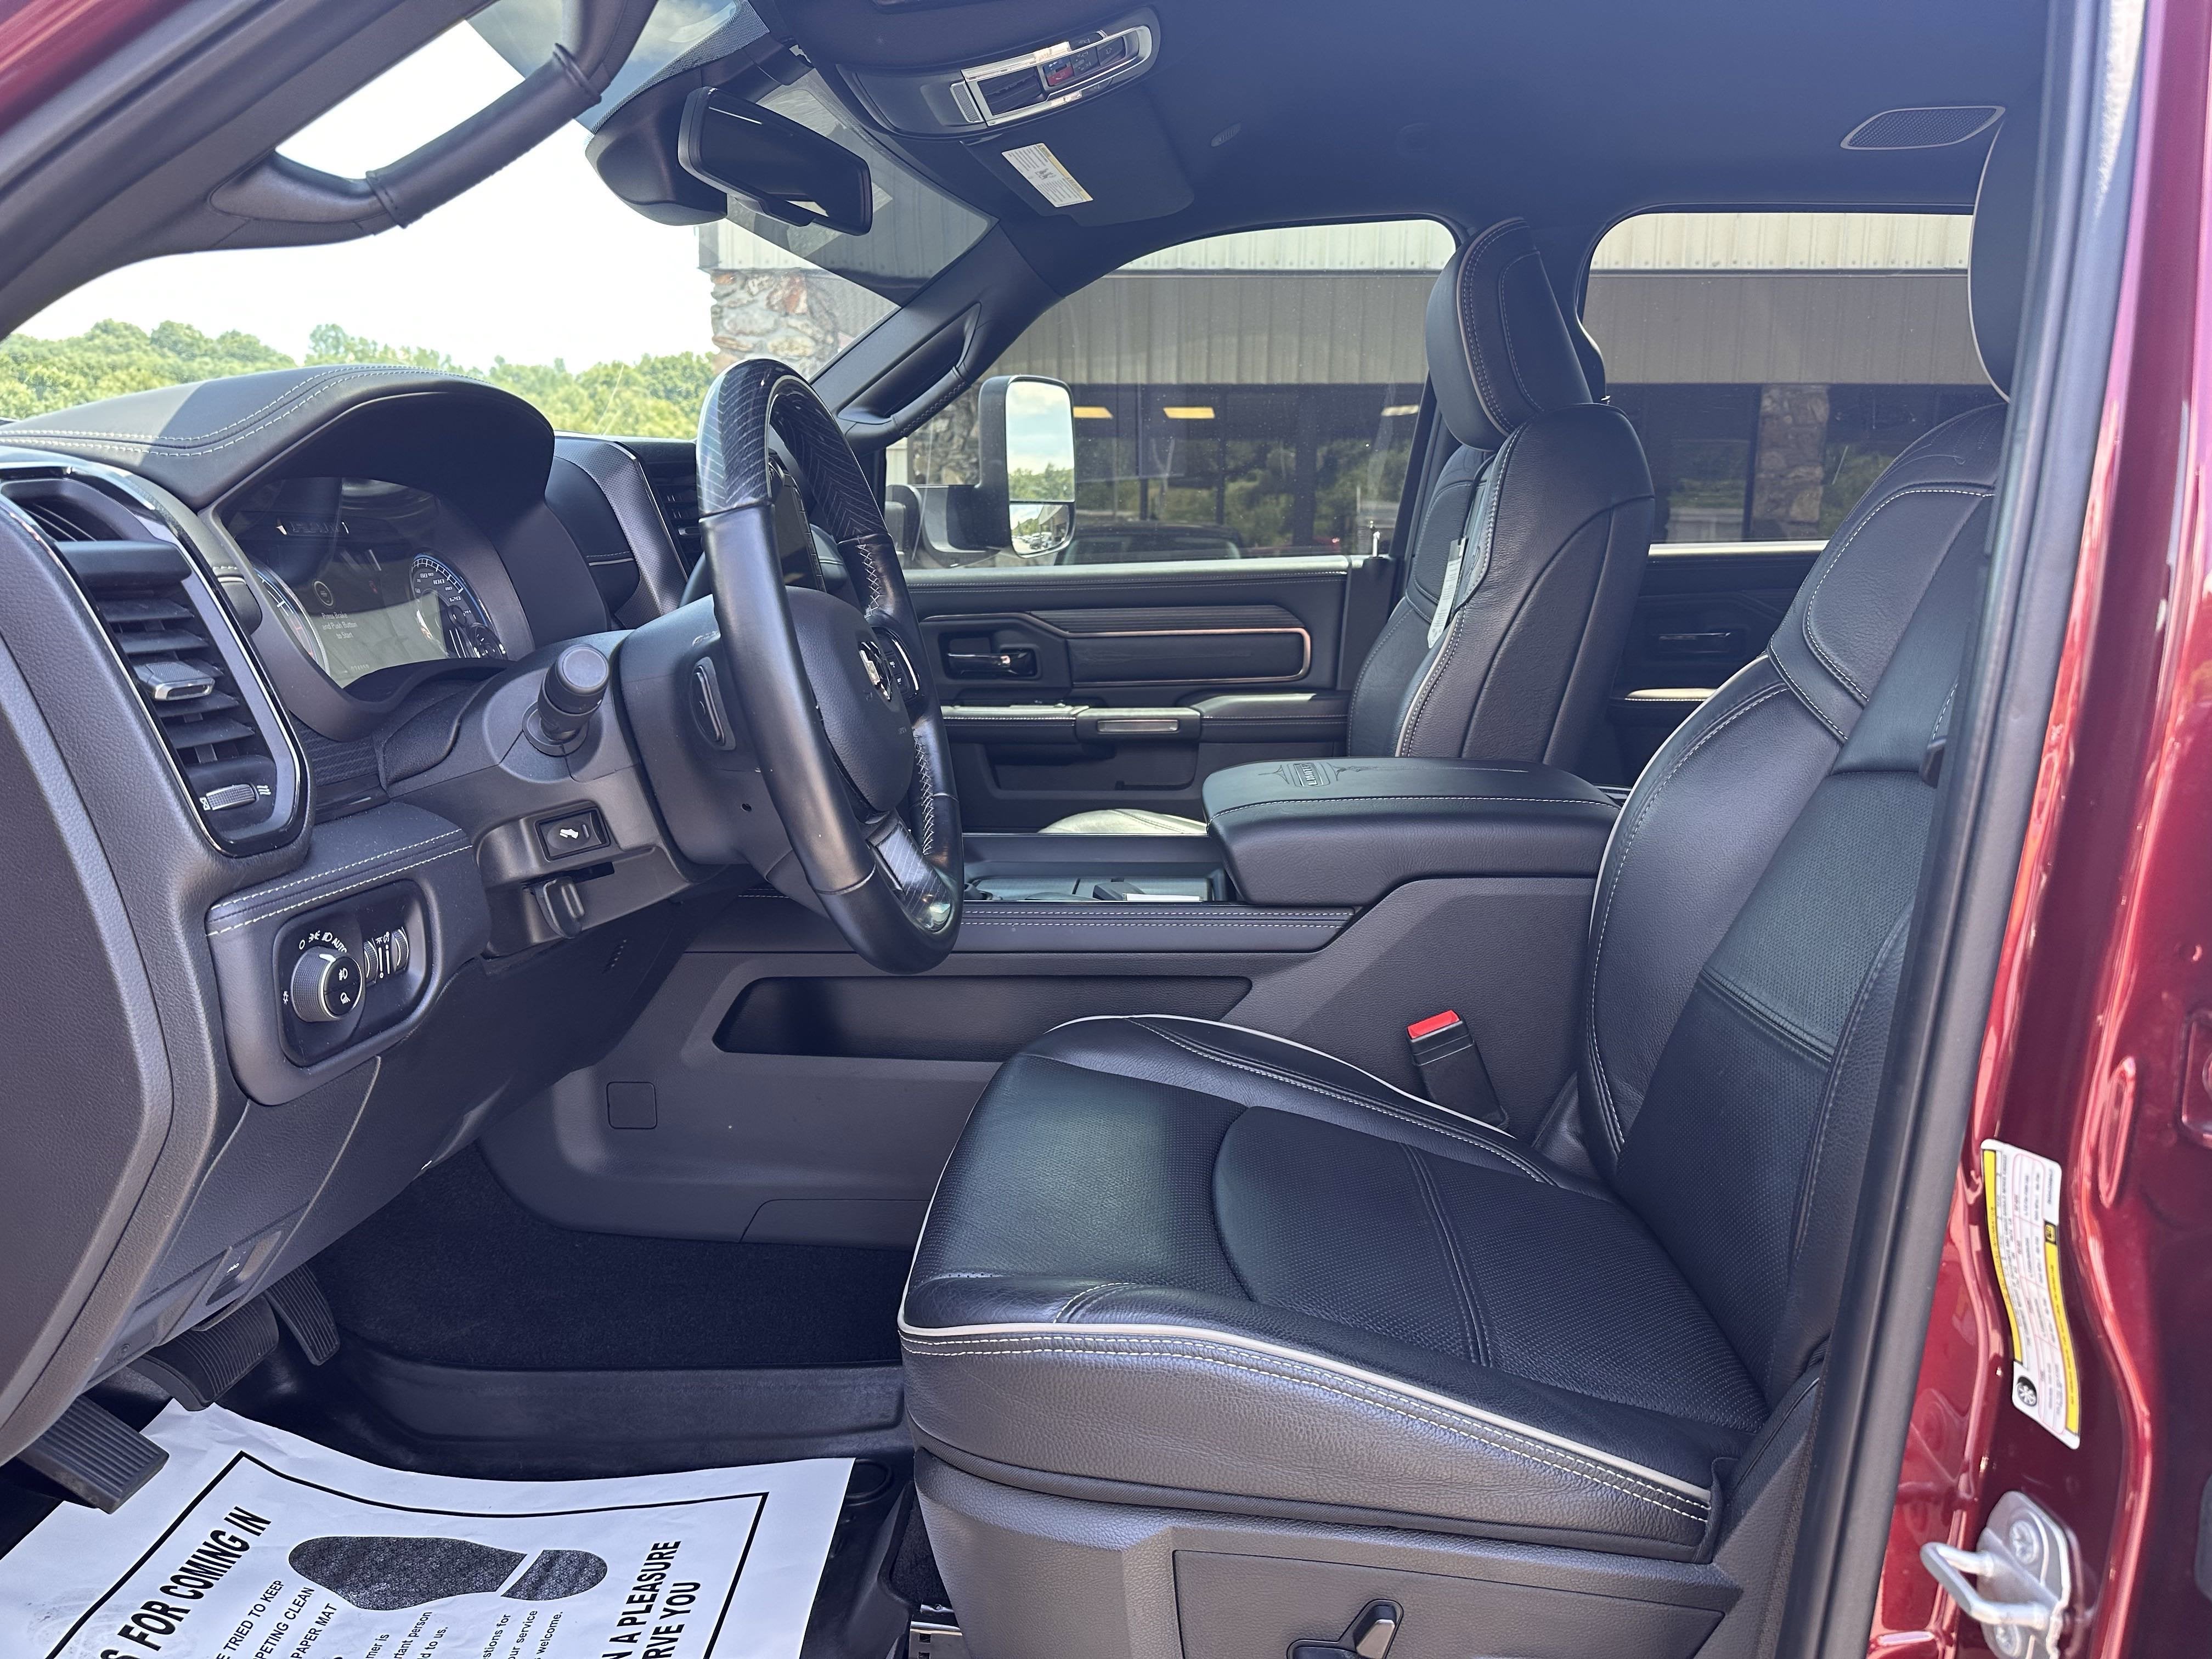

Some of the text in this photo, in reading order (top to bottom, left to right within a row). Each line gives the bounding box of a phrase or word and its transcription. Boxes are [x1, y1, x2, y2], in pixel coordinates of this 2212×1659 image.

[331, 938, 347, 953] AUTO
[117, 1601, 191, 1651] FOR
[159, 1530, 250, 1600] COMING
[223, 1506, 272, 1537] IN
[616, 1541, 681, 1627] PLEASURE
[223, 1620, 253, 1651] TRIED
[247, 1604, 266, 1617] TO
[260, 1580, 284, 1602] KEEP
[658, 1582, 701, 1620] YOU
[252, 1587, 315, 1659] PETING CLEAN
[290, 1603, 337, 1658] PAPER MAT
[408, 1612, 432, 1638] person
[425, 1641, 438, 1650] to
[433, 1627, 448, 1638] us.
[483, 1614, 511, 1659] stions for
[516, 1611, 538, 1644] service
[536, 1612, 563, 1655] welcome.
[609, 1632, 642, 1644] A
